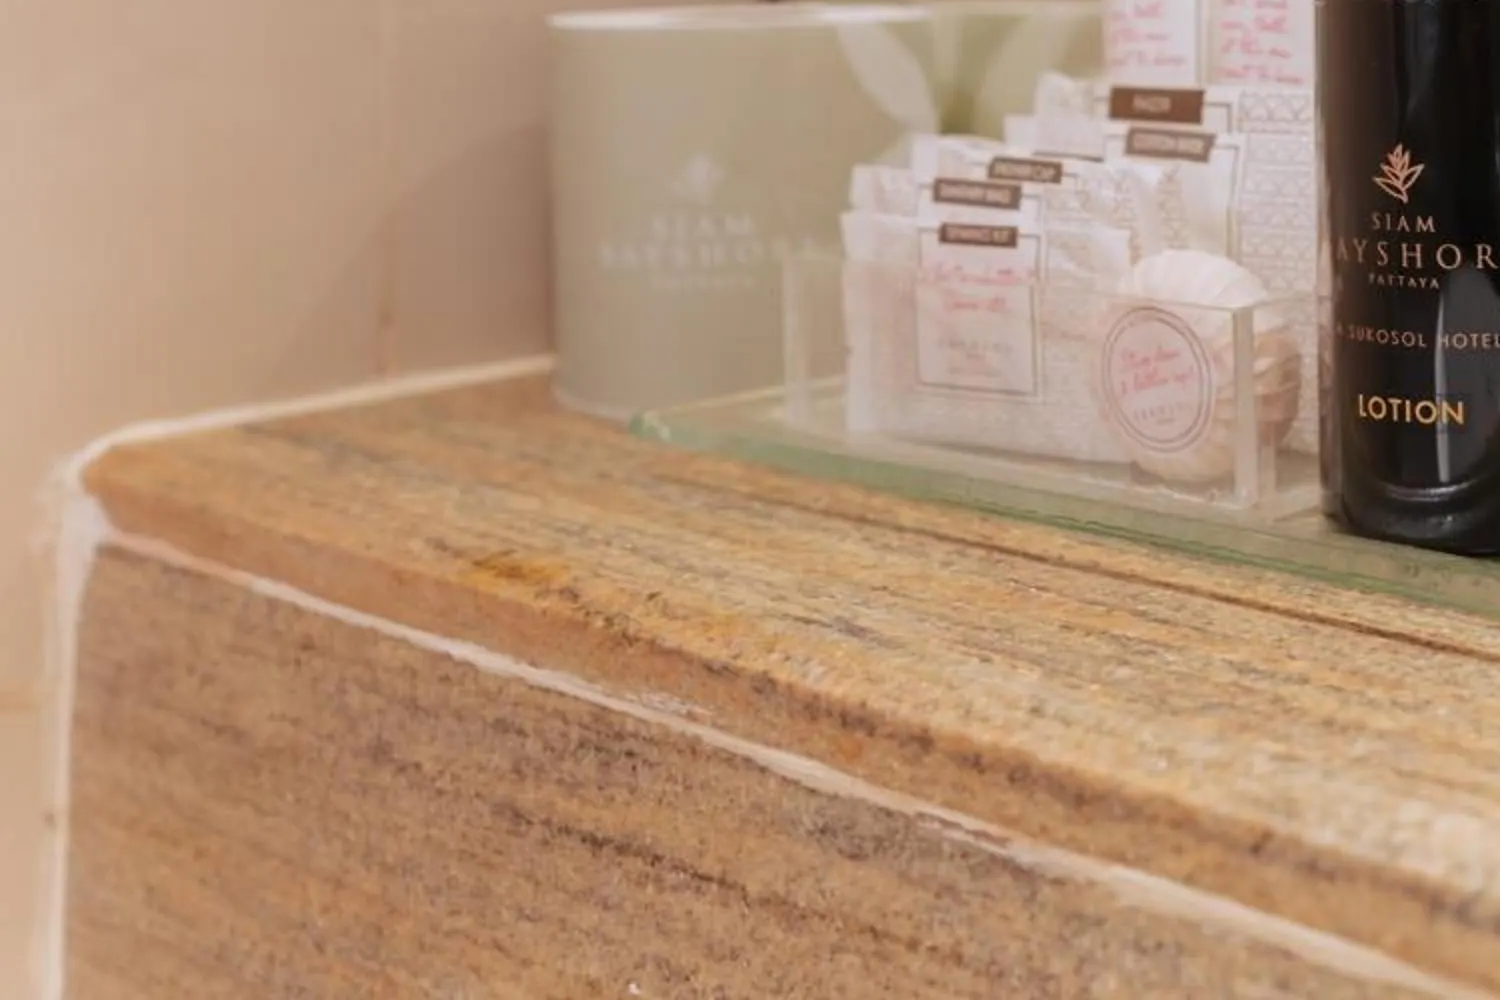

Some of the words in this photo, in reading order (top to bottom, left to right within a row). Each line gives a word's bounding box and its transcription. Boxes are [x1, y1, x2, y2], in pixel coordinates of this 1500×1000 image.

[1371, 212, 1436, 234] SIAM
[1368, 272, 1440, 290] PATTAYA
[1348, 325, 1428, 349] SUKOSOL
[1358, 393, 1465, 426] LOTION
